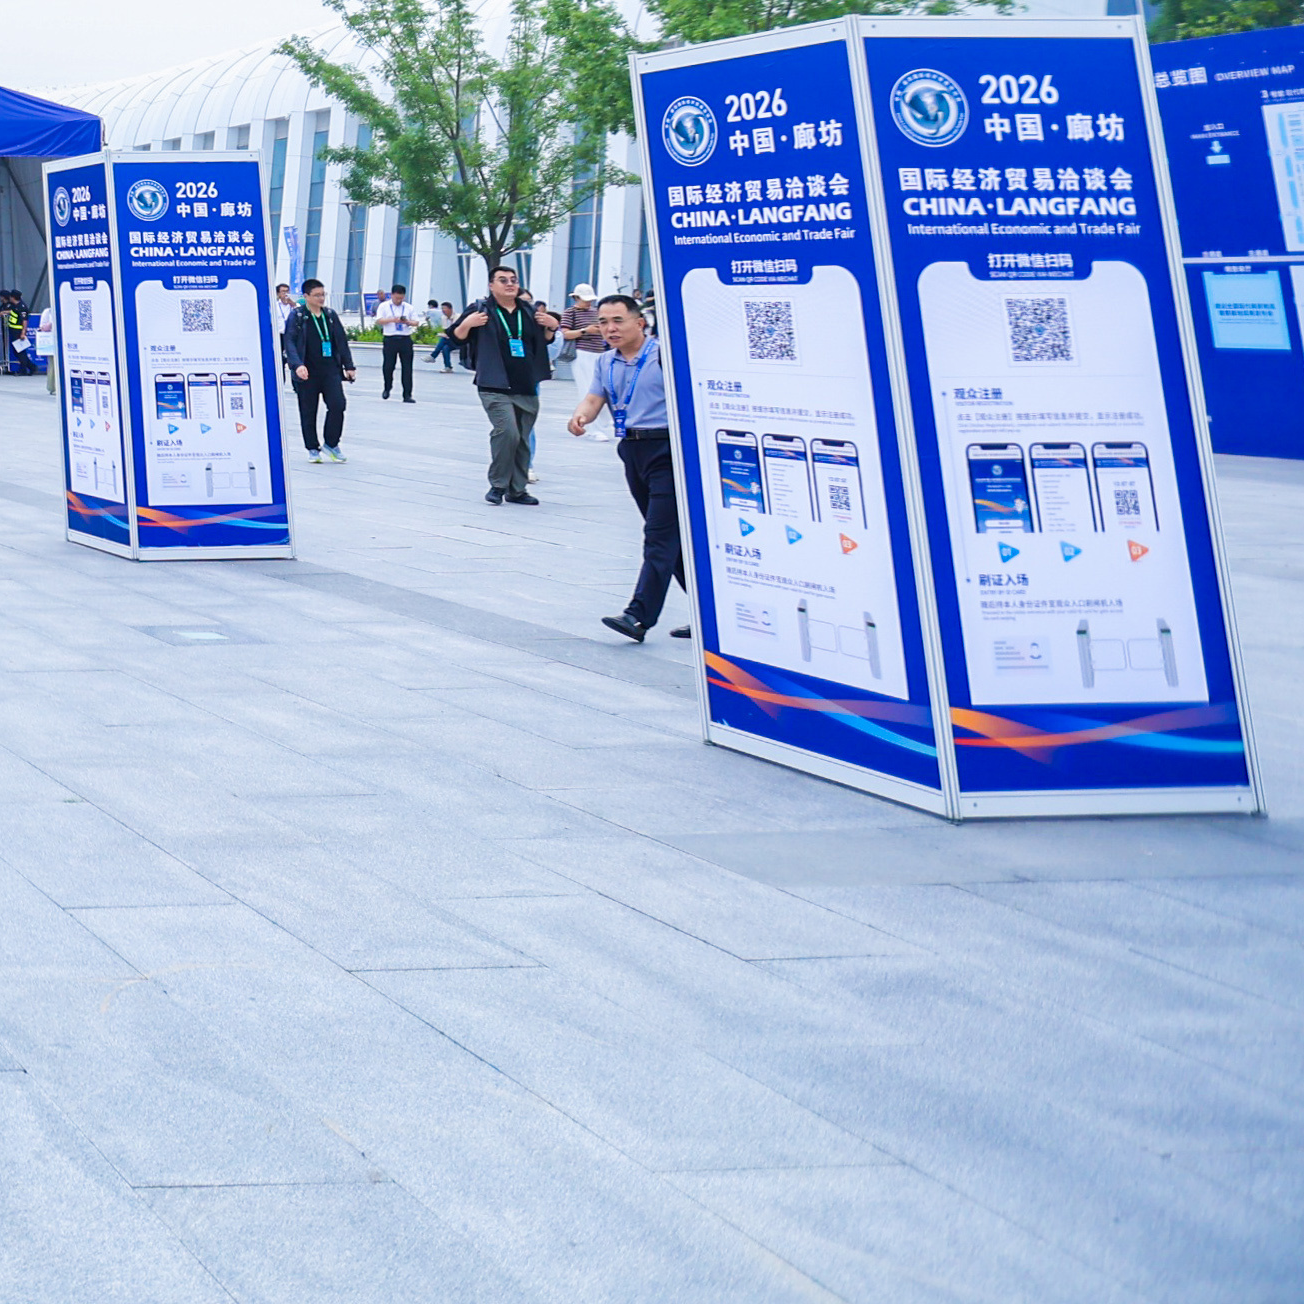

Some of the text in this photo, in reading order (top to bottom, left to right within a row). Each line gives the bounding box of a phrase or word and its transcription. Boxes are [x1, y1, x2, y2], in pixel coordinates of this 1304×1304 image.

[1270, 65, 1295, 75] MAP
[978, 74, 1060, 104] 2026
[724, 87, 788, 122] 2026
[983, 112, 1127, 141] 中国·廊坊
[728, 117, 844, 157] 中国·廊坊
[896, 168, 1134, 191] 国际经济贸易洽谈会
[71, 185, 90, 203] 2026
[175, 182, 218, 197] 2026
[667, 172, 850, 207] 国际经济贸易洽谈会
[176, 201, 252, 217] 中国·廊坊
[670, 202, 851, 228] CHINA·LANGFANG
[900, 197, 1136, 215] CHINA·LANGFANG
[128, 230, 254, 243] 国际经济贸易洽谈会
[673, 226, 855, 245] International Economic and Trade Fair
[906, 222, 1141, 235] International Economic and Trade Fair
[129, 246, 254, 256] CHINA·LANGFANG
[730, 258, 797, 273] 打开微信扫码
[985, 253, 1073, 268] 打开微信扫码
[953, 388, 1002, 399] 观众注册
